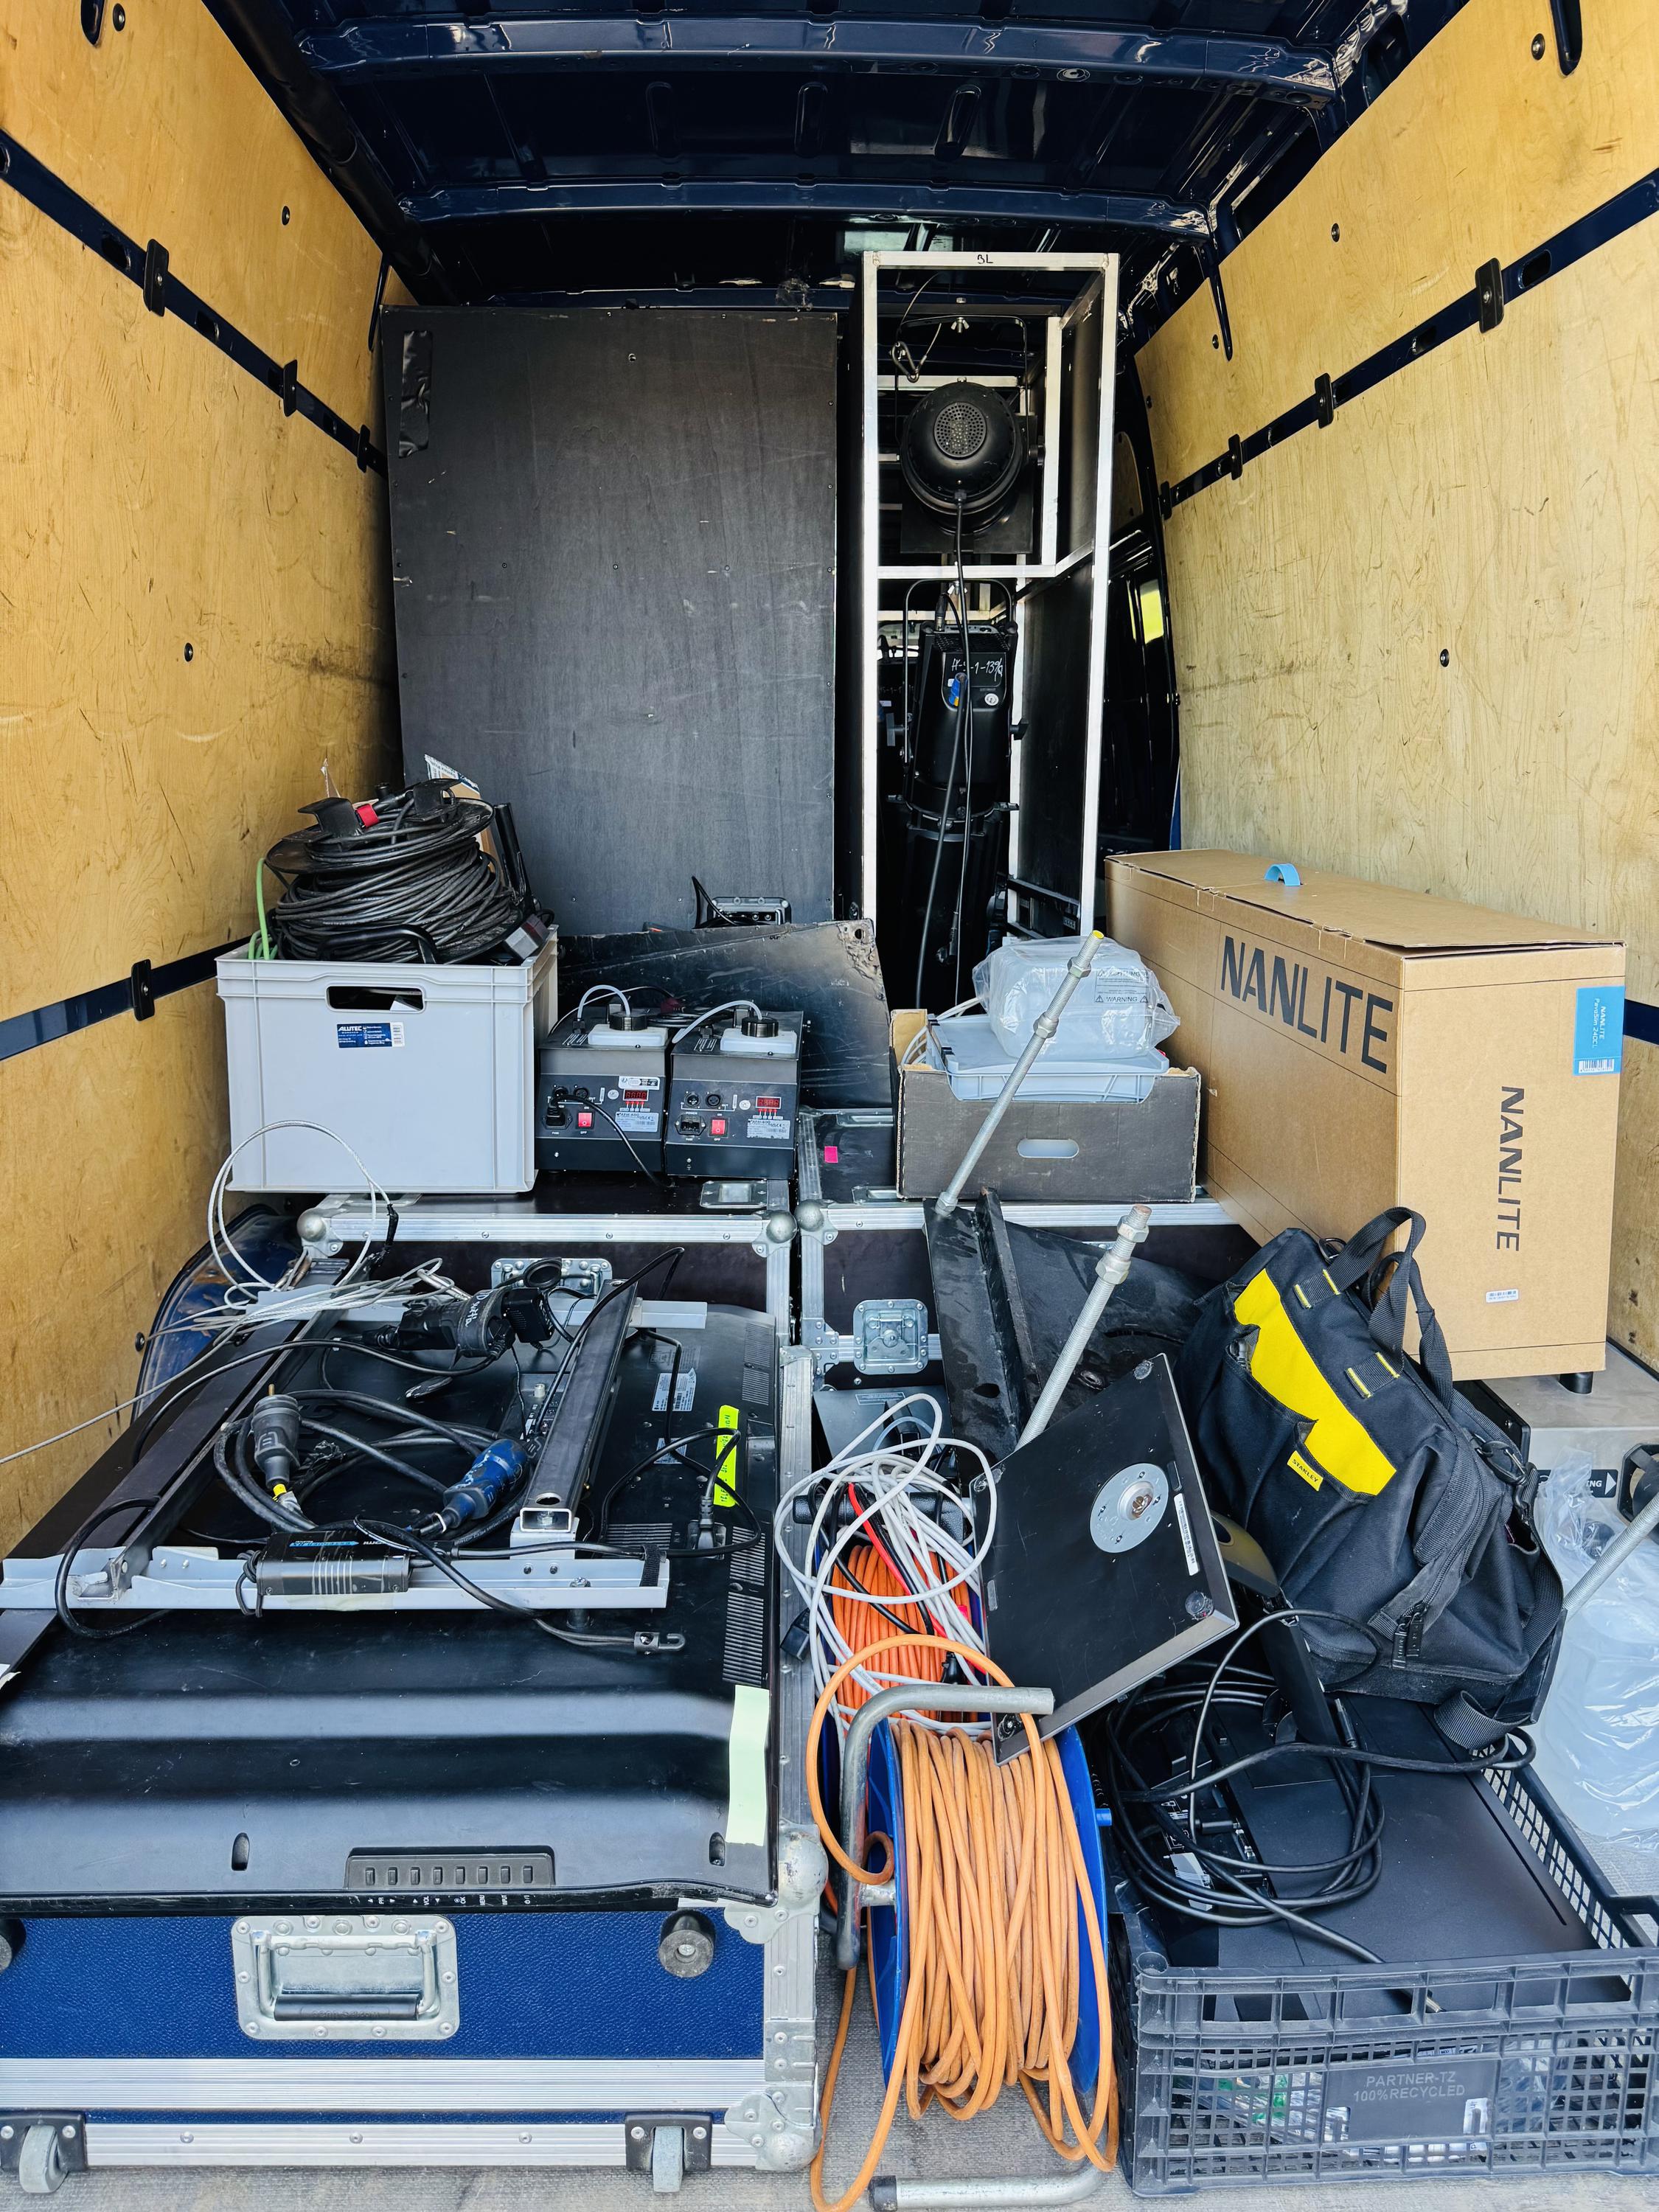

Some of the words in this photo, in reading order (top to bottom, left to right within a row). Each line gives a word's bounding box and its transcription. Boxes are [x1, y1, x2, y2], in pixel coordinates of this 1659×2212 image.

[1220, 935, 1394, 1074] NANLITE
[1496, 1085, 1526, 1252] NANLITE
[1292, 1458, 1319, 1482] STANLEY
[1366, 2070, 1457, 2088] PARTNER-TZ
